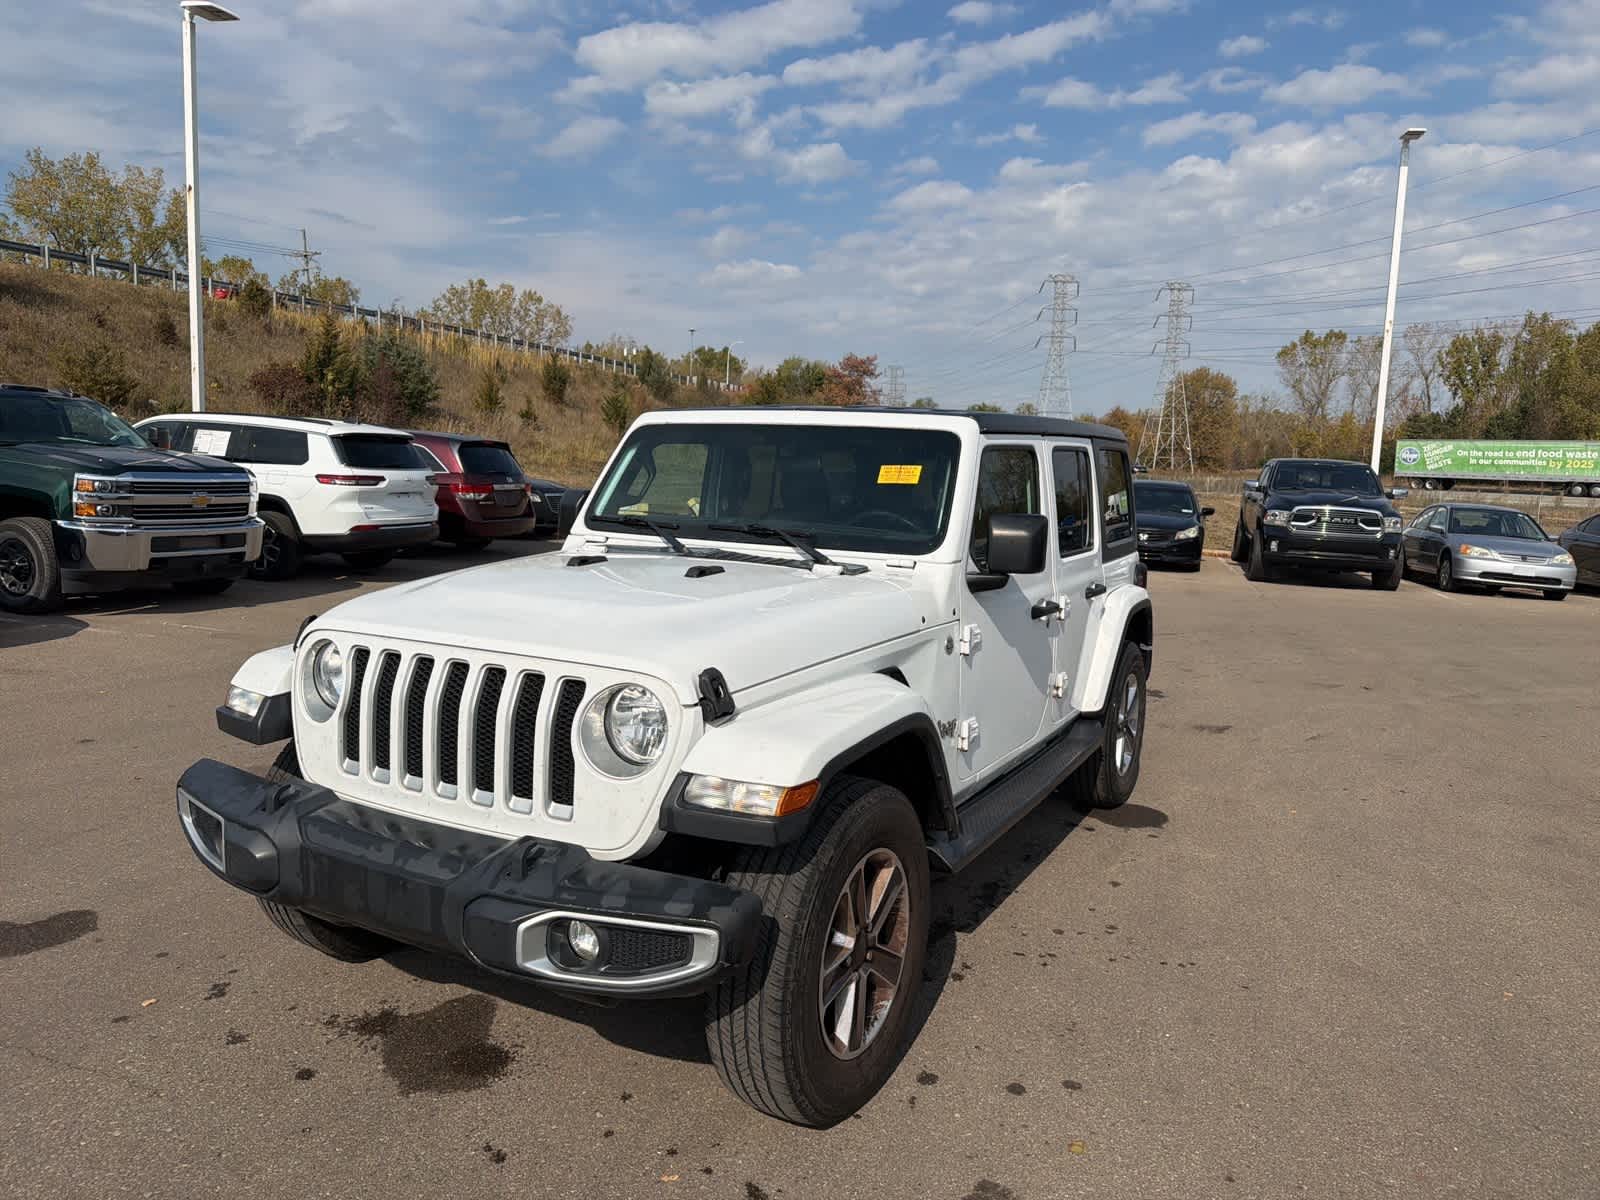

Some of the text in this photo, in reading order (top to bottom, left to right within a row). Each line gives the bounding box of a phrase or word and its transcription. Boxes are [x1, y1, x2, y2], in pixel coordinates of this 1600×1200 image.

[1470, 449, 1483, 457] the
[1484, 449, 1504, 457] road
[1516, 449, 1536, 458] end
[1538, 448, 1563, 458] food
[1427, 458, 1452, 471] WASTE
[1549, 458, 1563, 469] by
[1566, 460, 1594, 468] 2025
